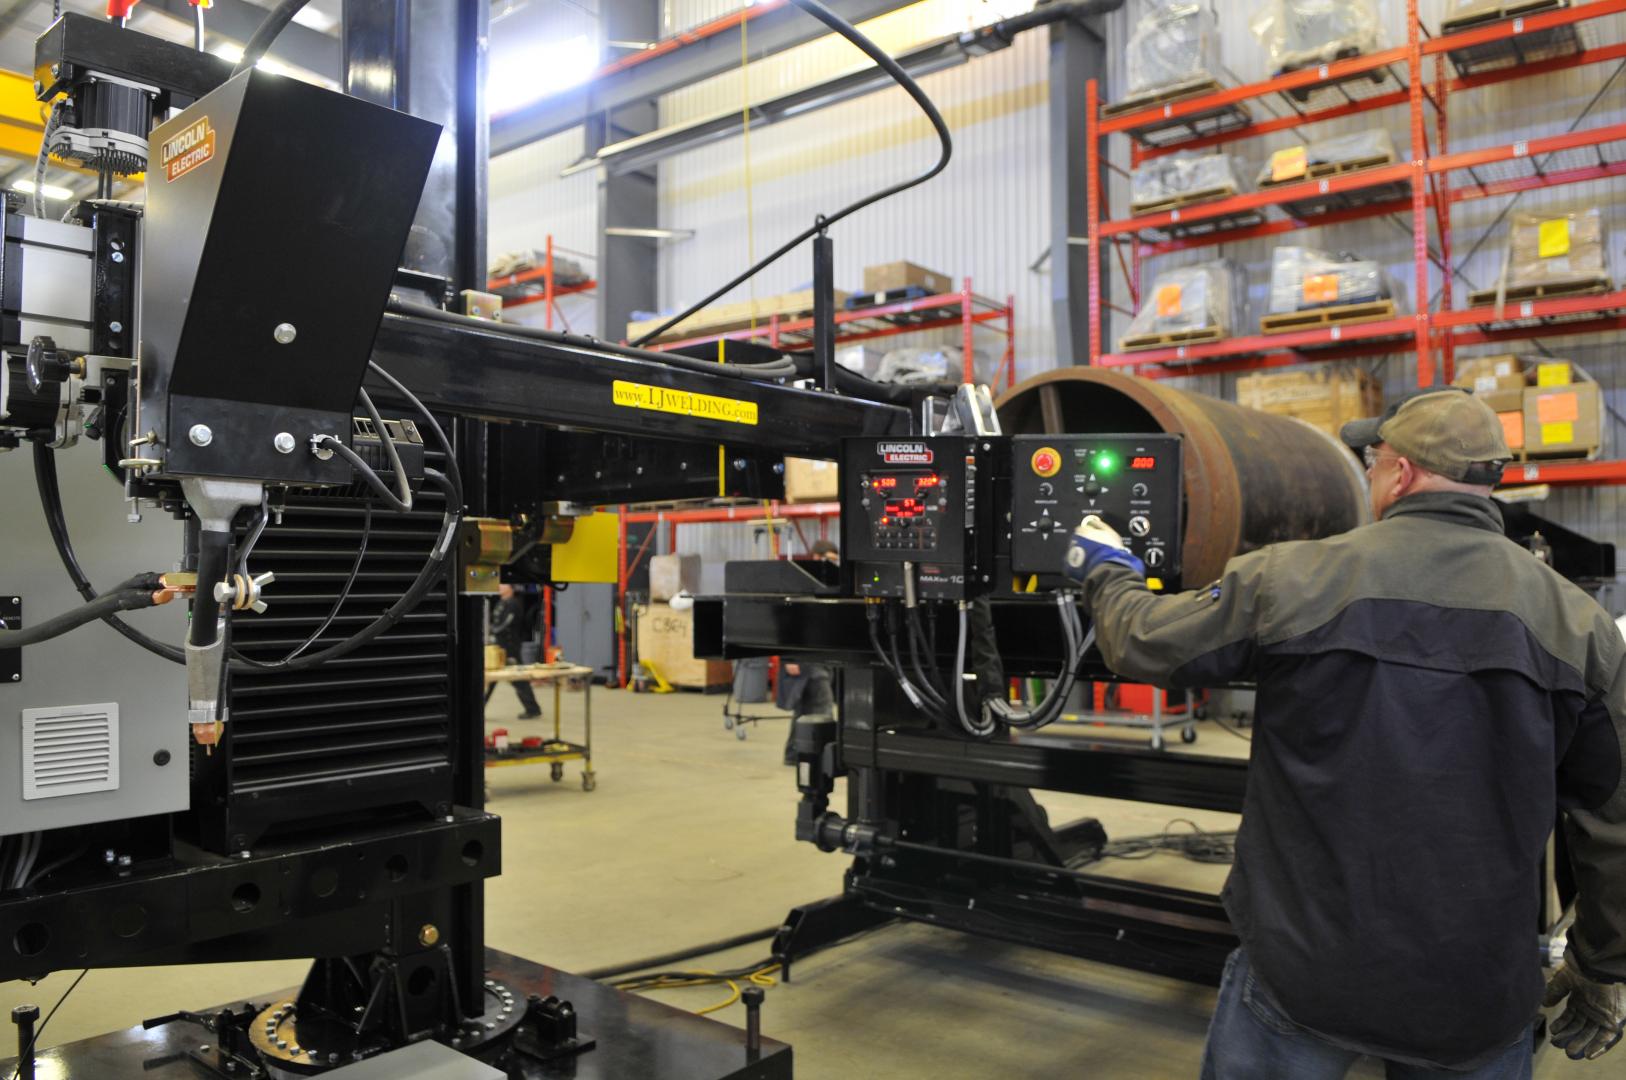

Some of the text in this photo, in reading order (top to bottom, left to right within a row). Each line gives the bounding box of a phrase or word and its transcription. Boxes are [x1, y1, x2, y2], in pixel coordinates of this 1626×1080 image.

[163, 122, 205, 162] LINCOLN
[171, 143, 209, 176] ELECTRIC
[880, 444, 923, 453] LINCOLN
[889, 454, 928, 462] ELECTRIC
